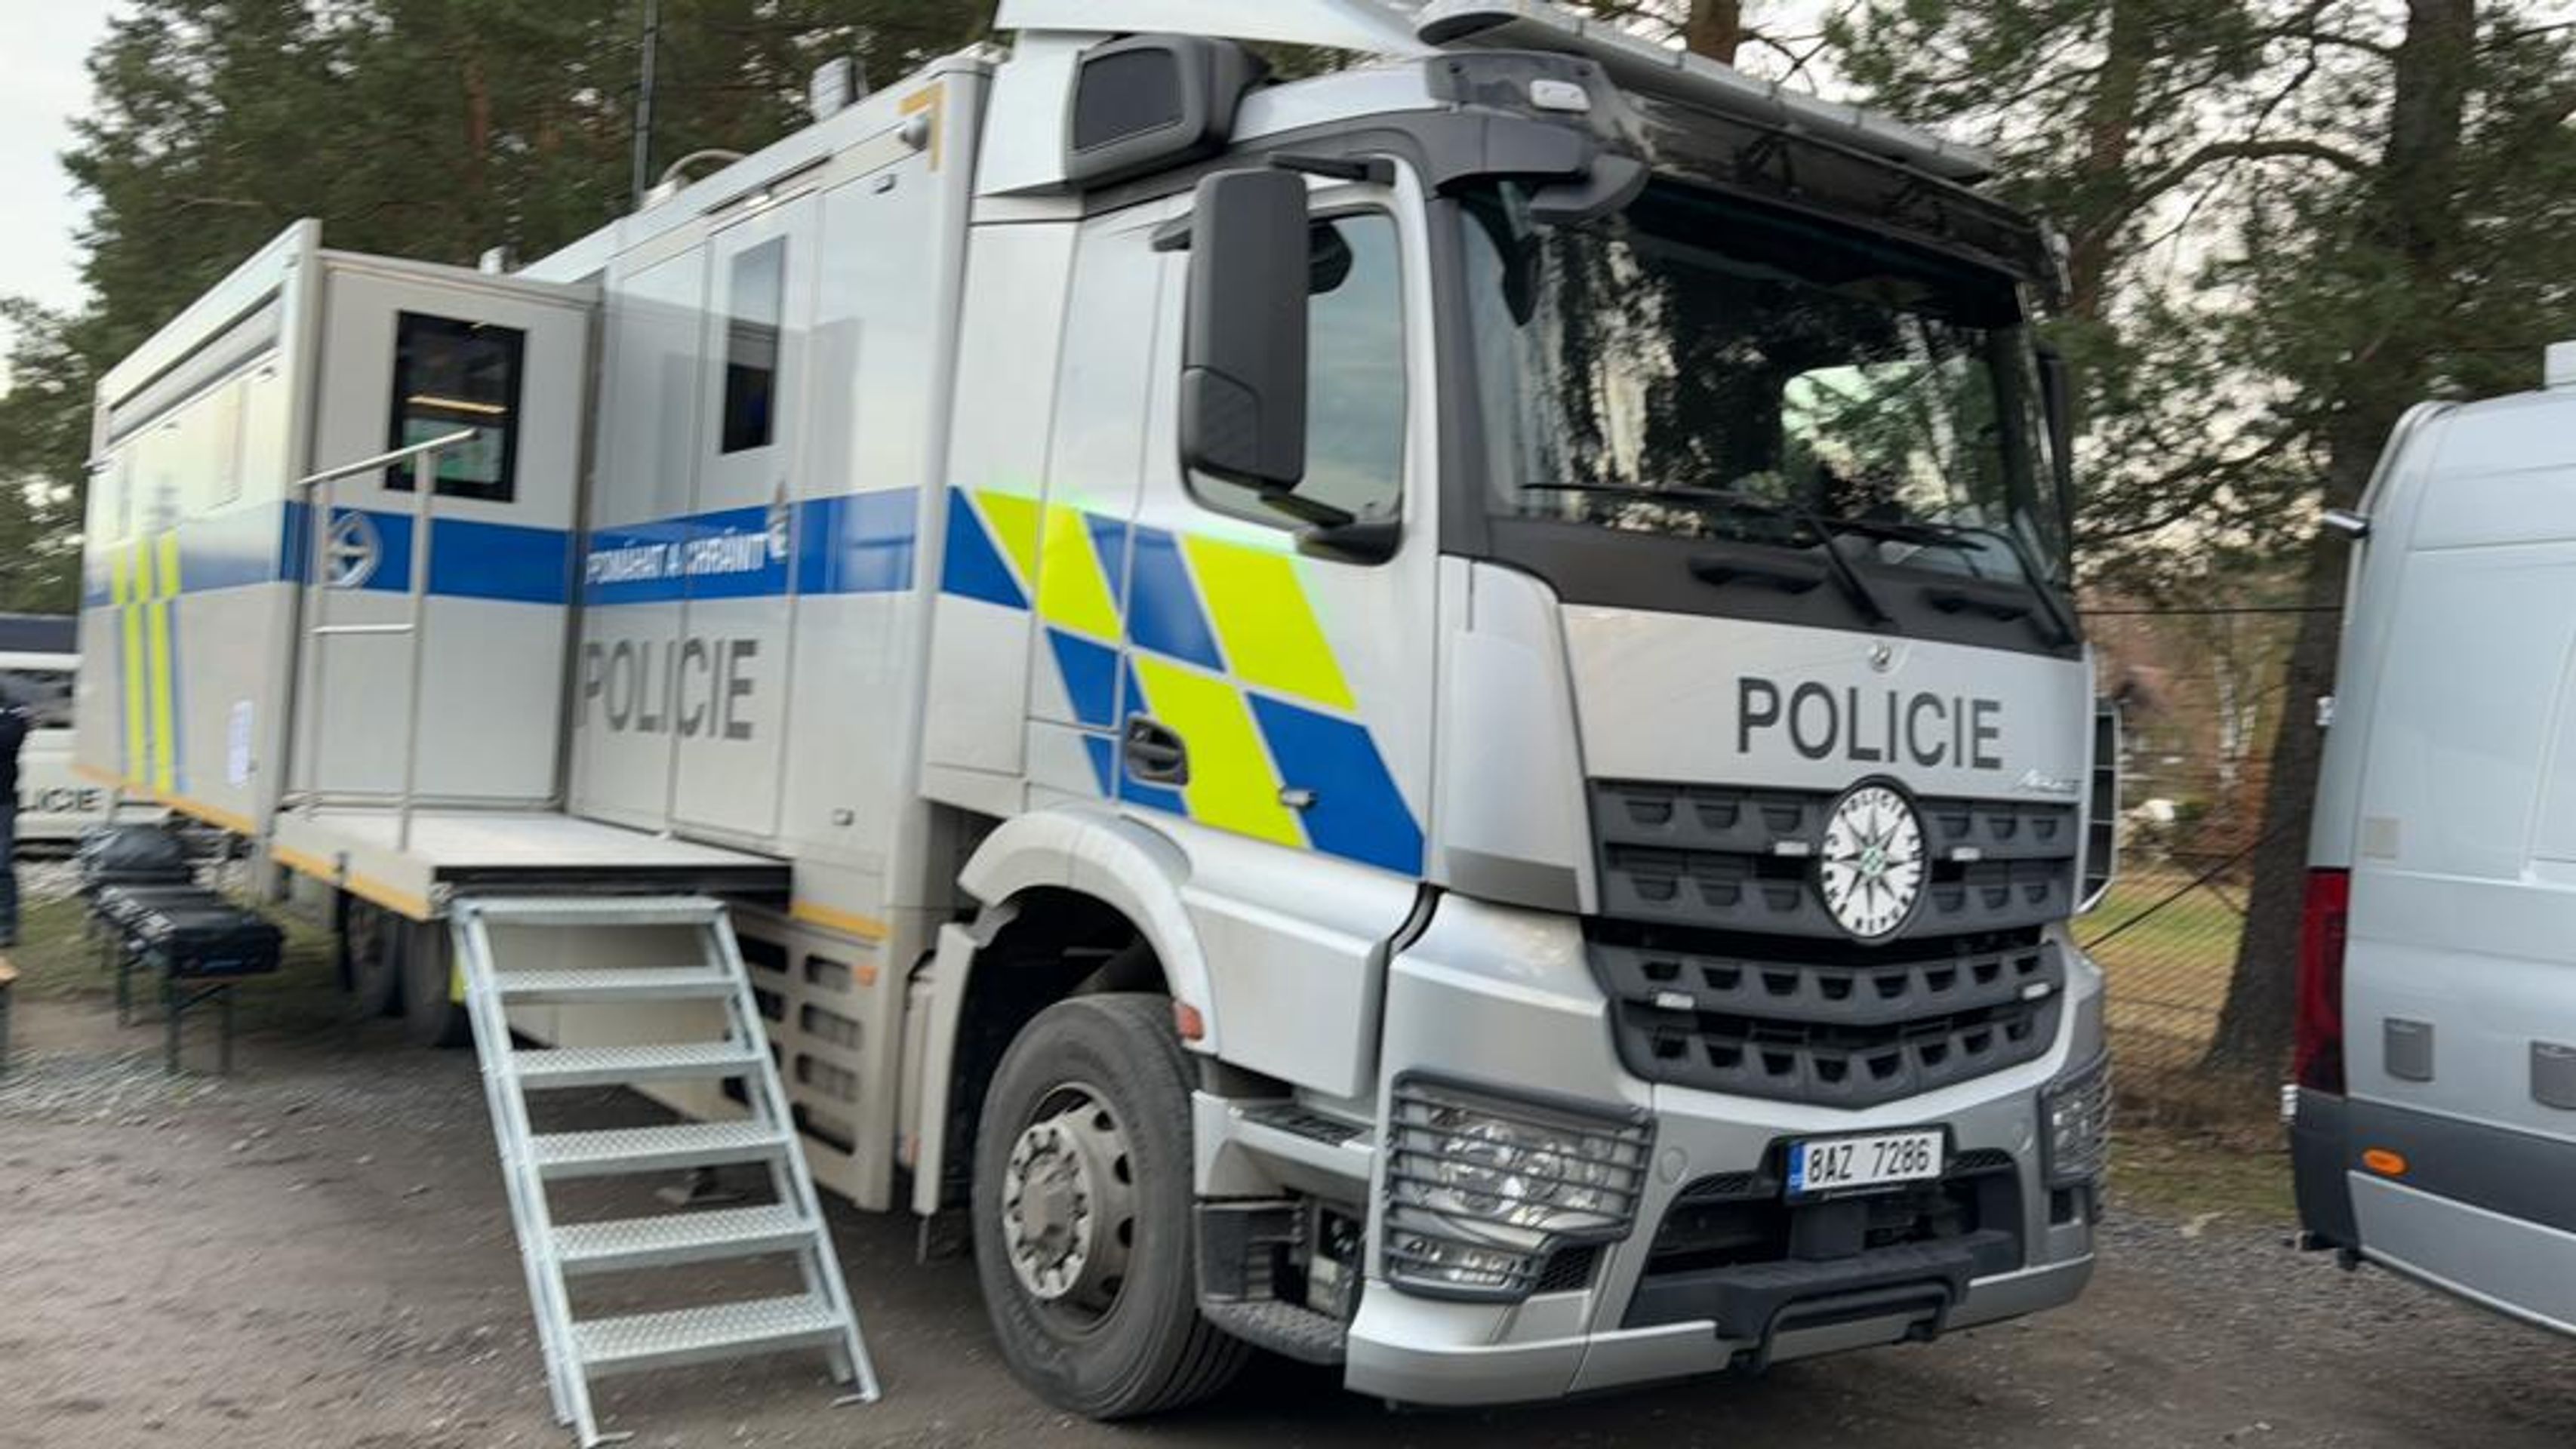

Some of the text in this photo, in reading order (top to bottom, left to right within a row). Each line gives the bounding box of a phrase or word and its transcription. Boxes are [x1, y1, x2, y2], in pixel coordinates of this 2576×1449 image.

[577, 638, 758, 740] POLICIE
[1737, 676, 2002, 770] POLICIE
[1809, 1137, 1930, 1183] 8AZ 7286
